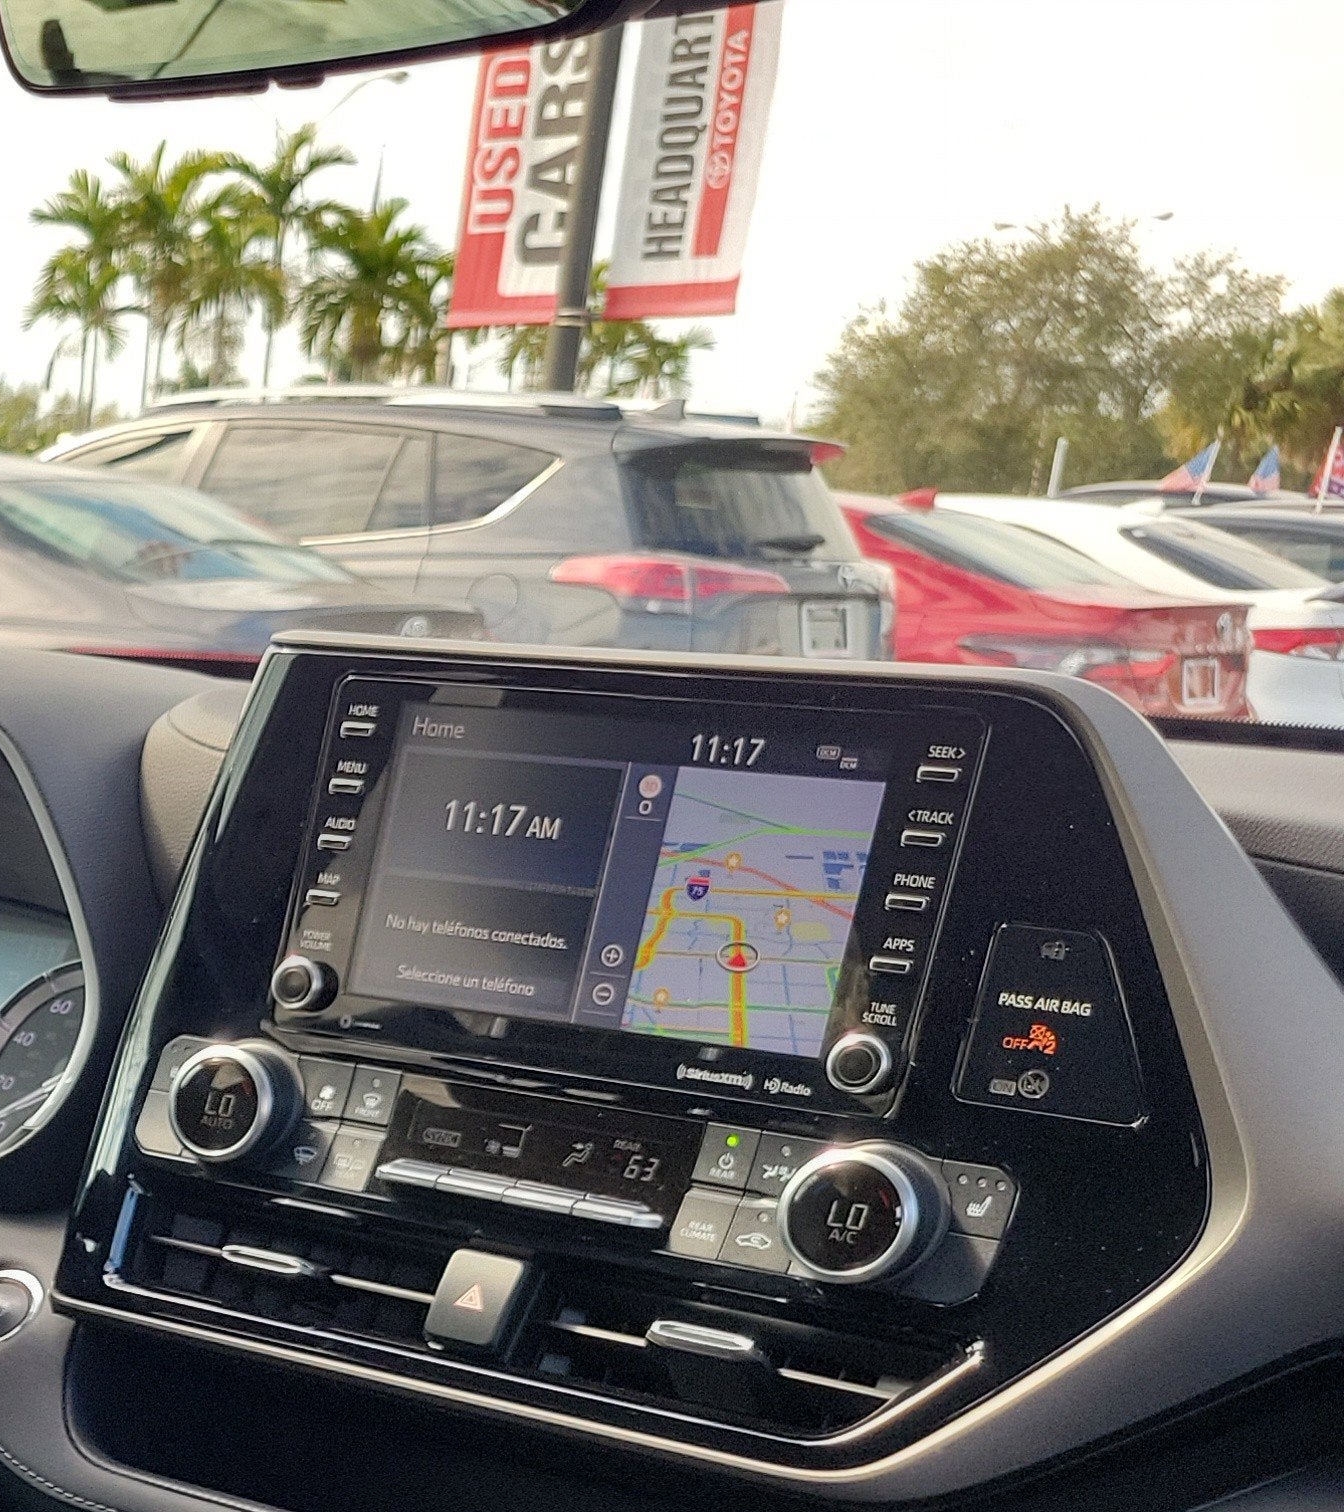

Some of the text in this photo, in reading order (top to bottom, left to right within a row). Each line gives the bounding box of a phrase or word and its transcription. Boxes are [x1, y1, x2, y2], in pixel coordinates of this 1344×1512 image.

[713, 29, 751, 150] TOYOTA
[473, 55, 532, 229] USED
[516, 38, 590, 264] CARS
[348, 704, 380, 717] HOME
[412, 716, 466, 740] Home
[691, 733, 766, 767] 11:17
[337, 760, 367, 775] MENU
[324, 816, 356, 830] AUDIO
[444, 799, 562, 841] 11:17 AM
[317, 872, 340, 886] MAP
[893, 873, 936, 889] PHONE
[690, 885, 705, 898] 75
[386, 914, 567, 950] No hay teléfonos conectados.
[883, 937, 916, 952] APPS
[396, 964, 535, 997] Seleccione un teléfono
[49, 1000, 73, 1015] 60
[870, 1002, 896, 1016] TUNE
[998, 992, 1093, 1018] PASS AIR BAG
[862, 1012, 897, 1027] SCROLL
[13, 1031, 36, 1047] 40
[1002, 1036, 1027, 1051] OFF
[781, 1081, 812, 1096] Radio
[311, 1099, 333, 1112] OFF
[623, 1155, 660, 1181] 63
[828, 1230, 859, 1244] A/C
